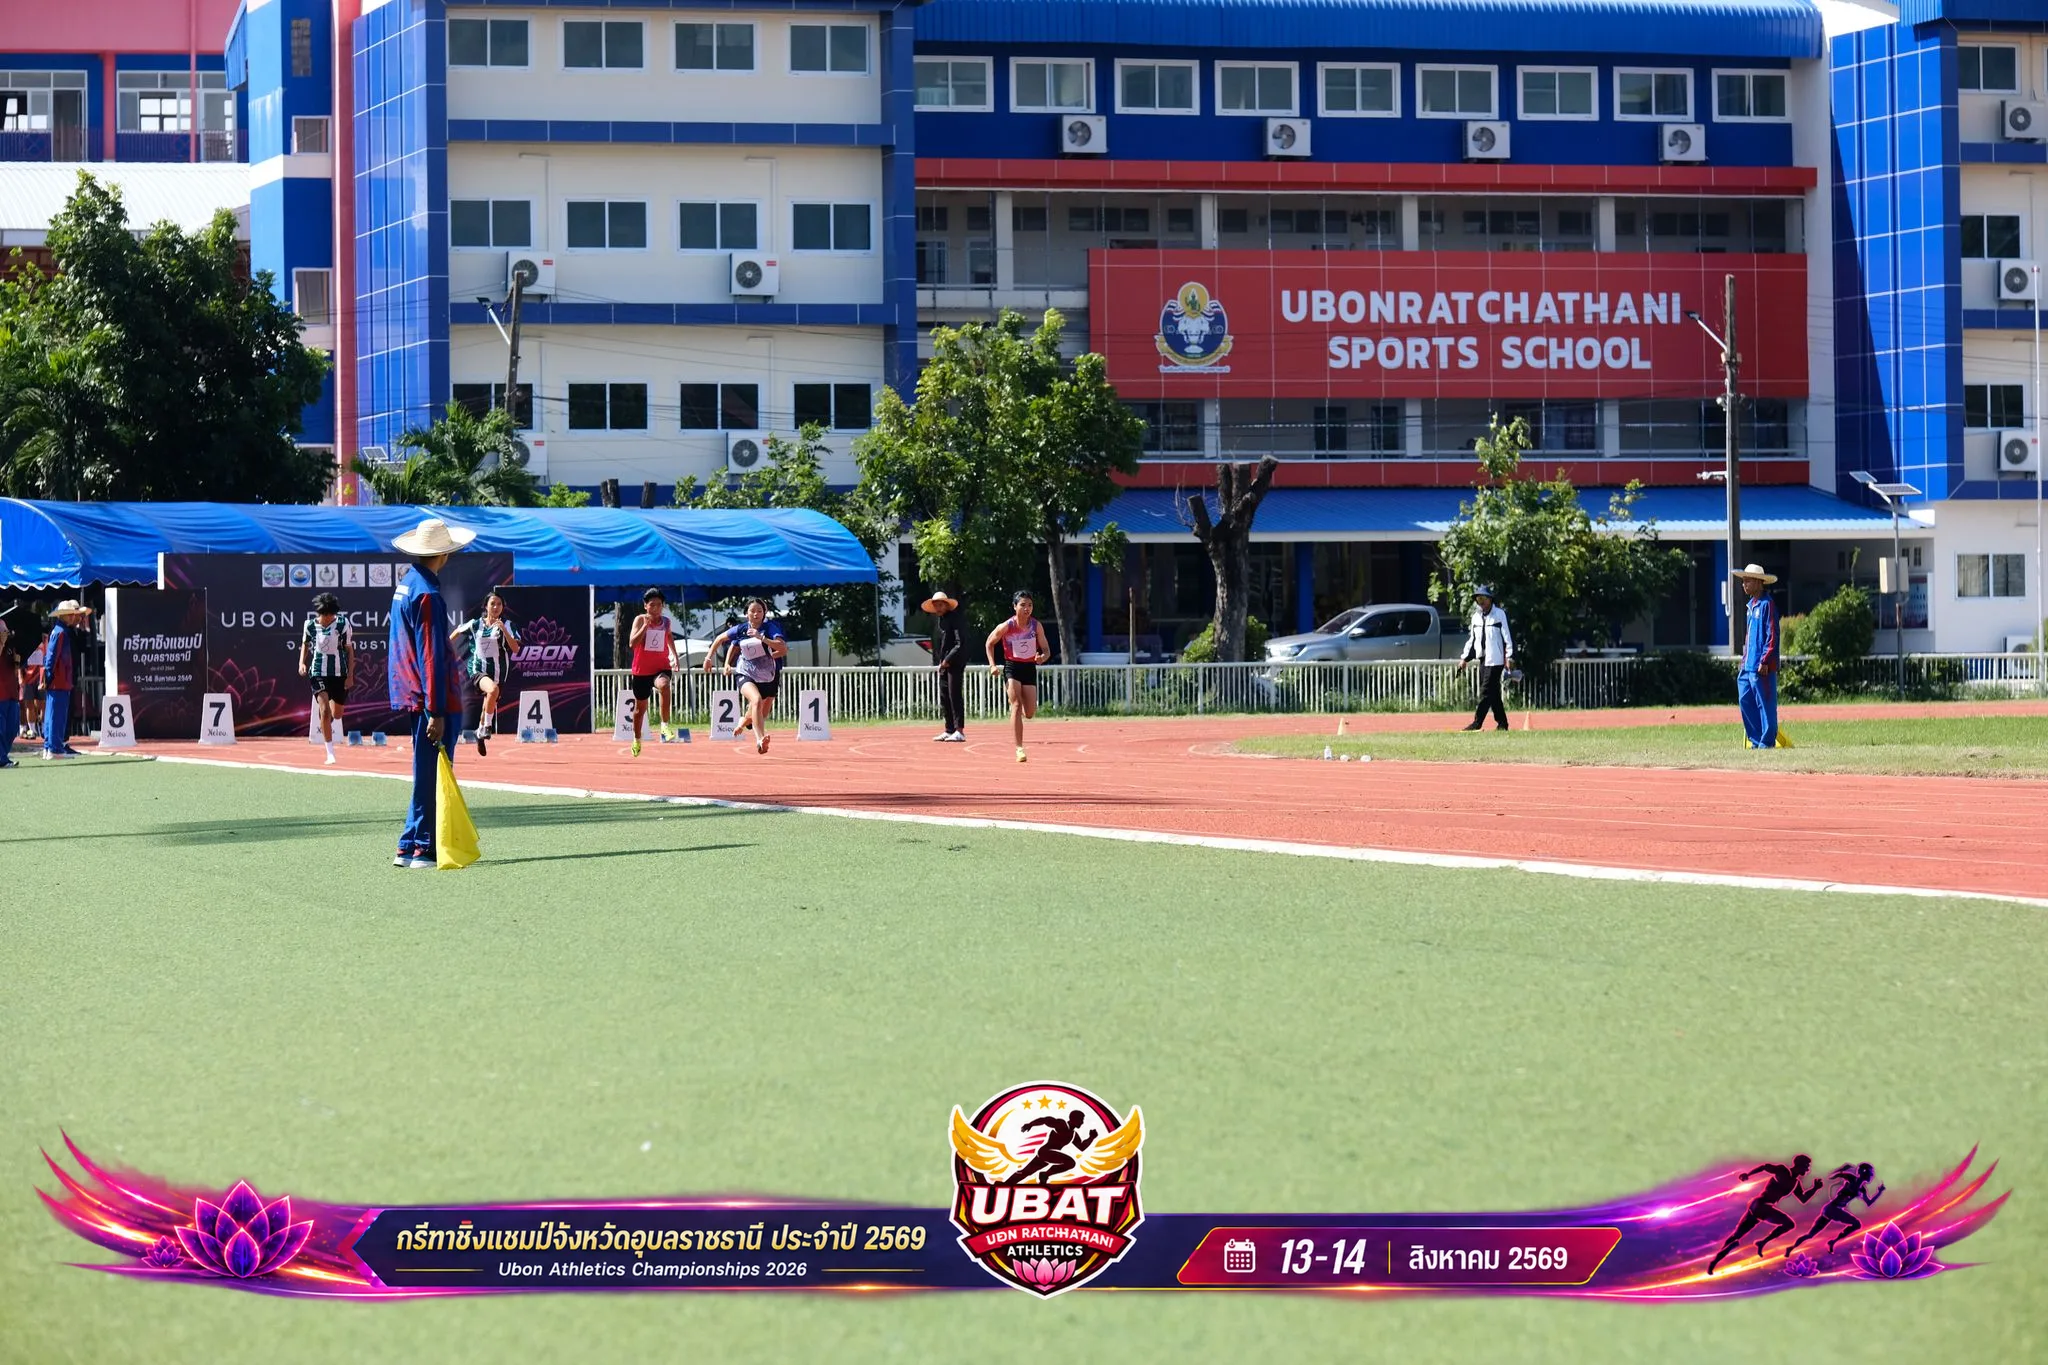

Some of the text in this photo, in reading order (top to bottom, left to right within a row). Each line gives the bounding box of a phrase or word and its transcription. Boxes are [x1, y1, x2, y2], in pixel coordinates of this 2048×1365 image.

[1281, 290, 1681, 324] UBONRATCHATHANI
[1328, 336, 1651, 370] SPORTS SCHOOL
[221, 611, 294, 628] UBON
[320, 639, 330, 653] 8
[481, 641, 491, 654] 7
[651, 633, 659, 647] 6
[1019, 641, 1030, 654] 3
[511, 645, 578, 661] UBON
[512, 661, 575, 670] ATHLETICS
[133, 675, 152, 683] 12-14
[109, 703, 125, 728] 8
[209, 702, 226, 727] 7
[527, 699, 543, 724] 4
[624, 698, 636, 723] 3
[718, 698, 734, 723] 2
[808, 698, 820, 723] 1
